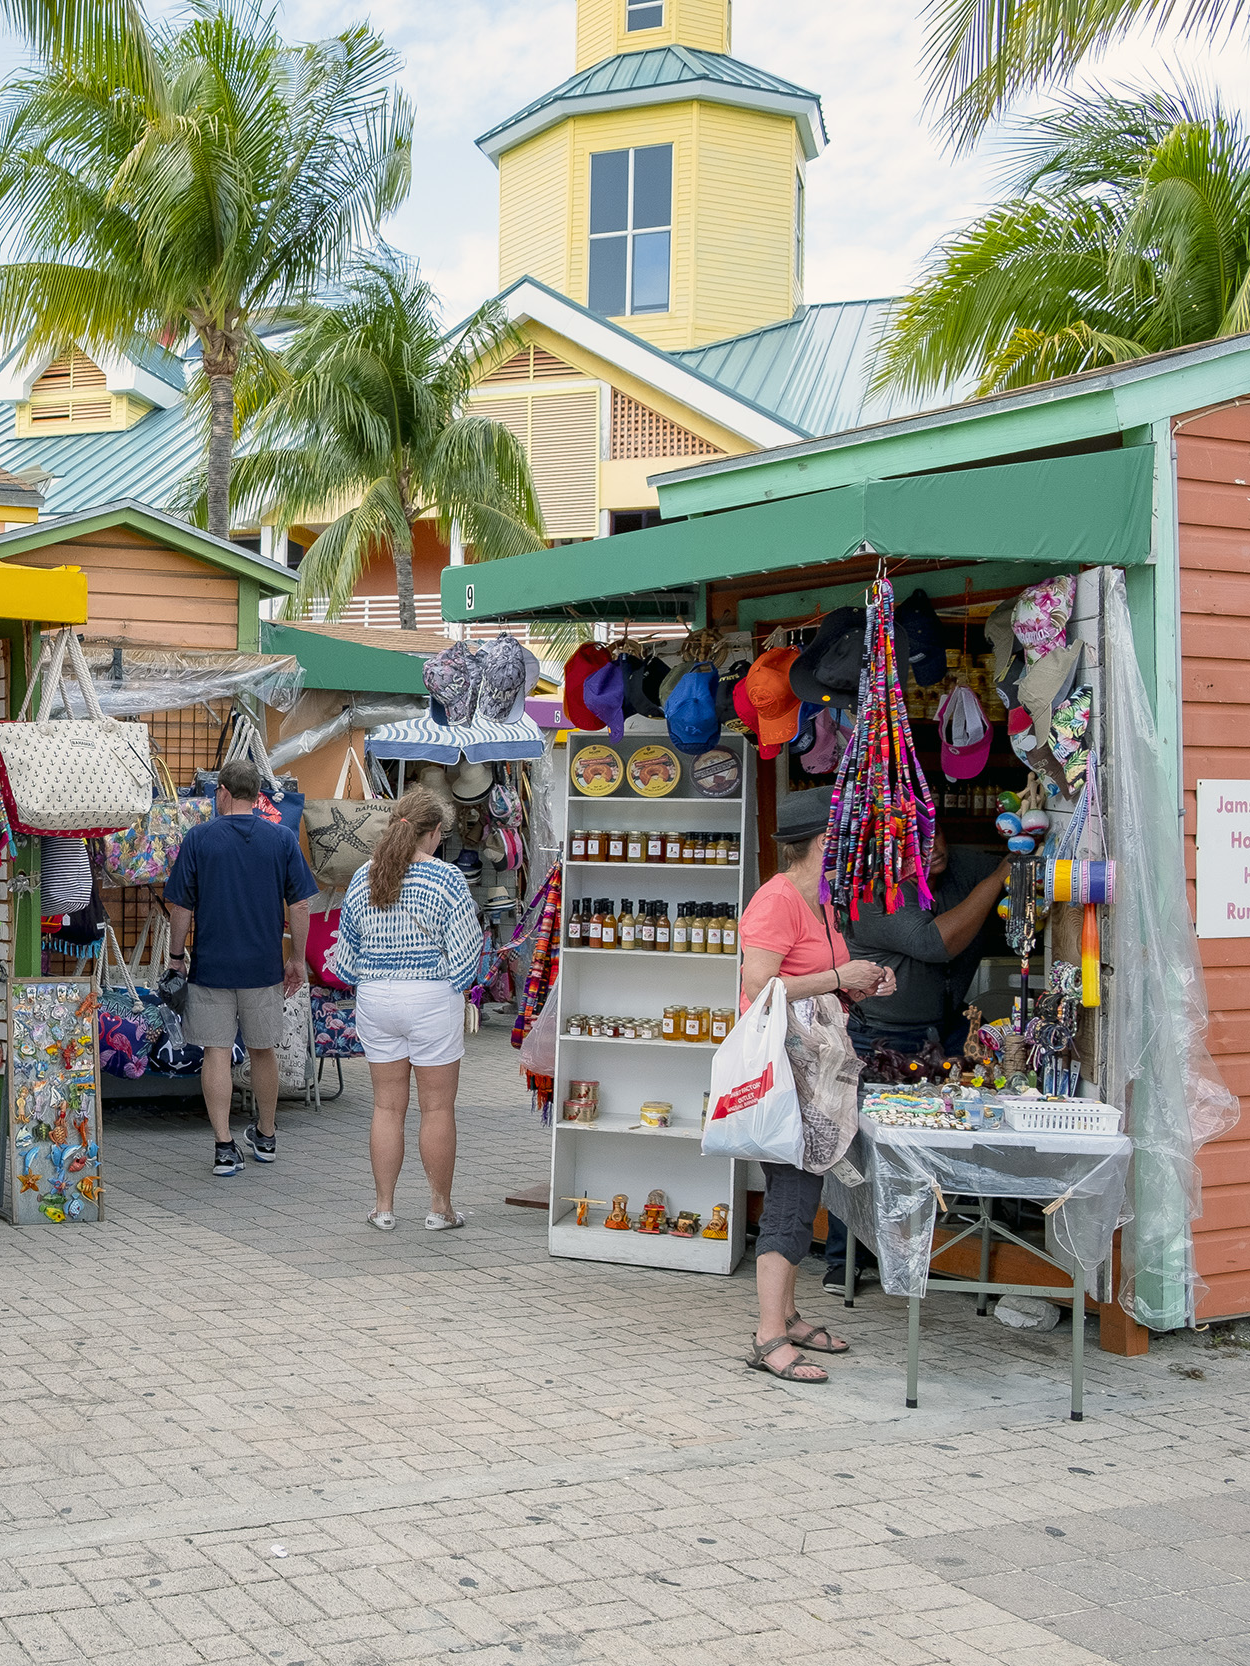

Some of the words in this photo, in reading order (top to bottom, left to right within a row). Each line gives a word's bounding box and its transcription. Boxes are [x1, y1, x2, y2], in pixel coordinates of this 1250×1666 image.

[467, 586, 473, 608] 9
[556, 712, 559, 722] 6
[737, 1091, 755, 1104] OUTLET
